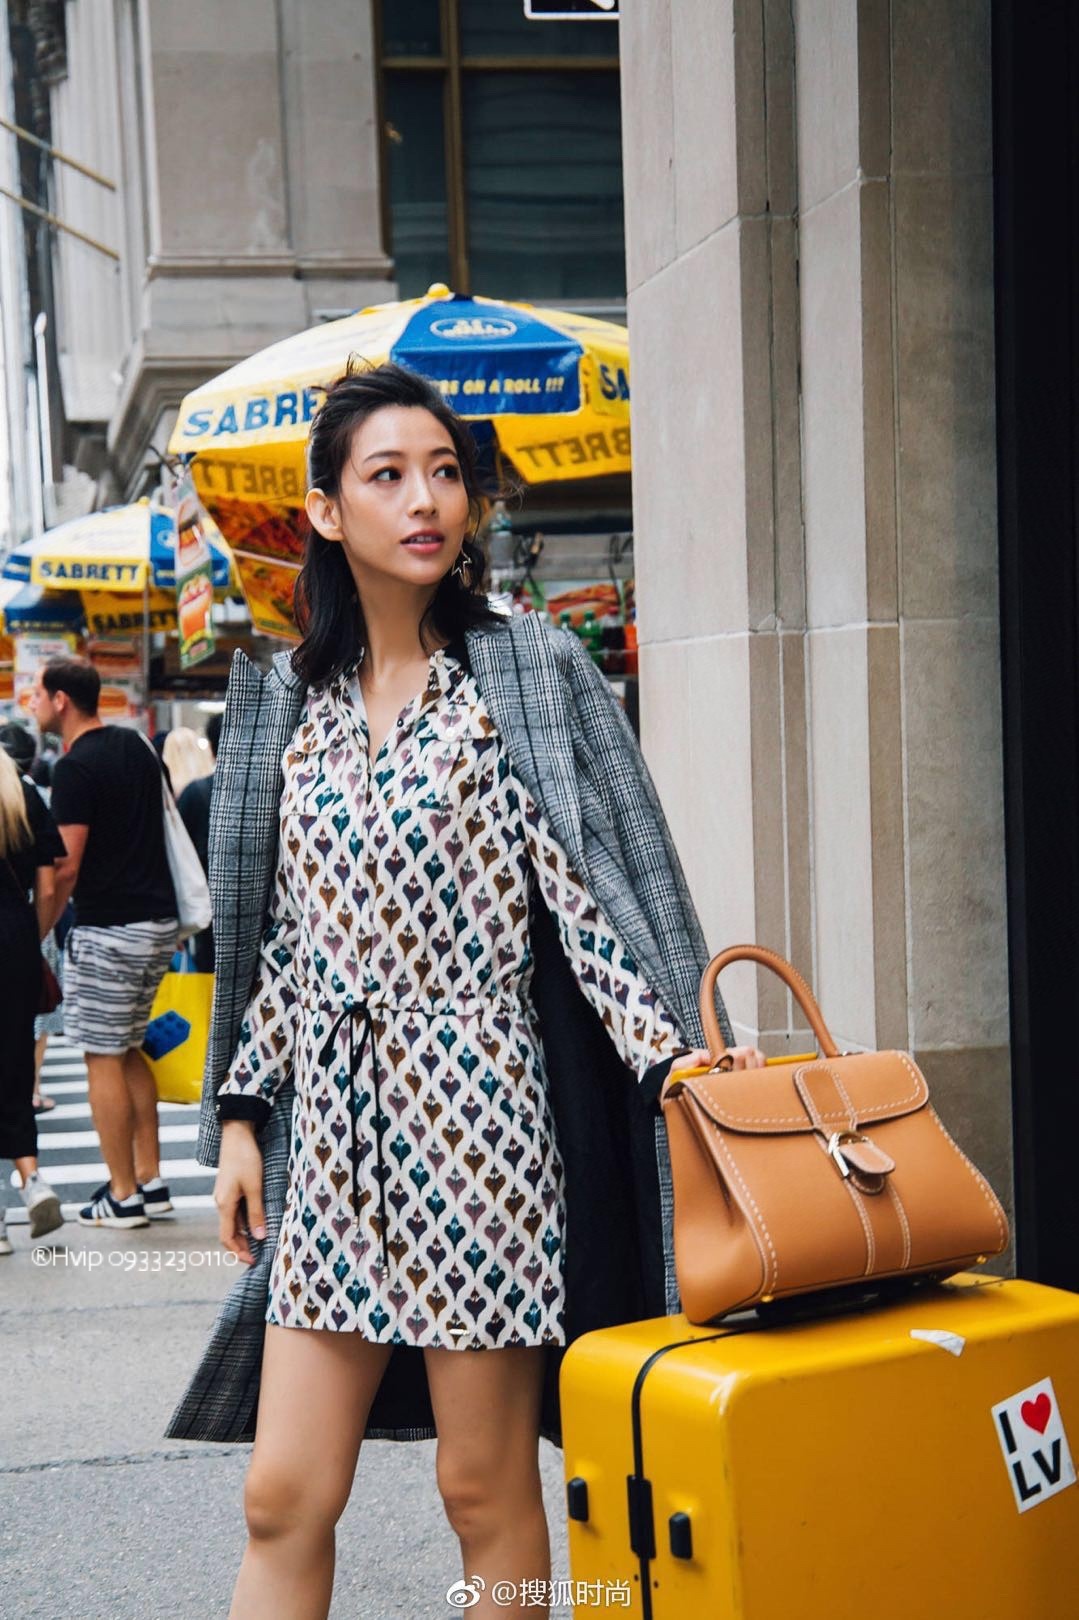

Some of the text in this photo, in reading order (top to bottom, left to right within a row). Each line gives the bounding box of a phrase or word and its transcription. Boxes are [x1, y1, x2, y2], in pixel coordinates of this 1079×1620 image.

[488, 378, 501, 395] A
[503, 377, 541, 394] ROLL
[183, 389, 319, 436] SABRE
[40, 560, 139, 581] SABRETT
[999, 1410, 1017, 1454] I
[1012, 1438, 1061, 1501] LV
